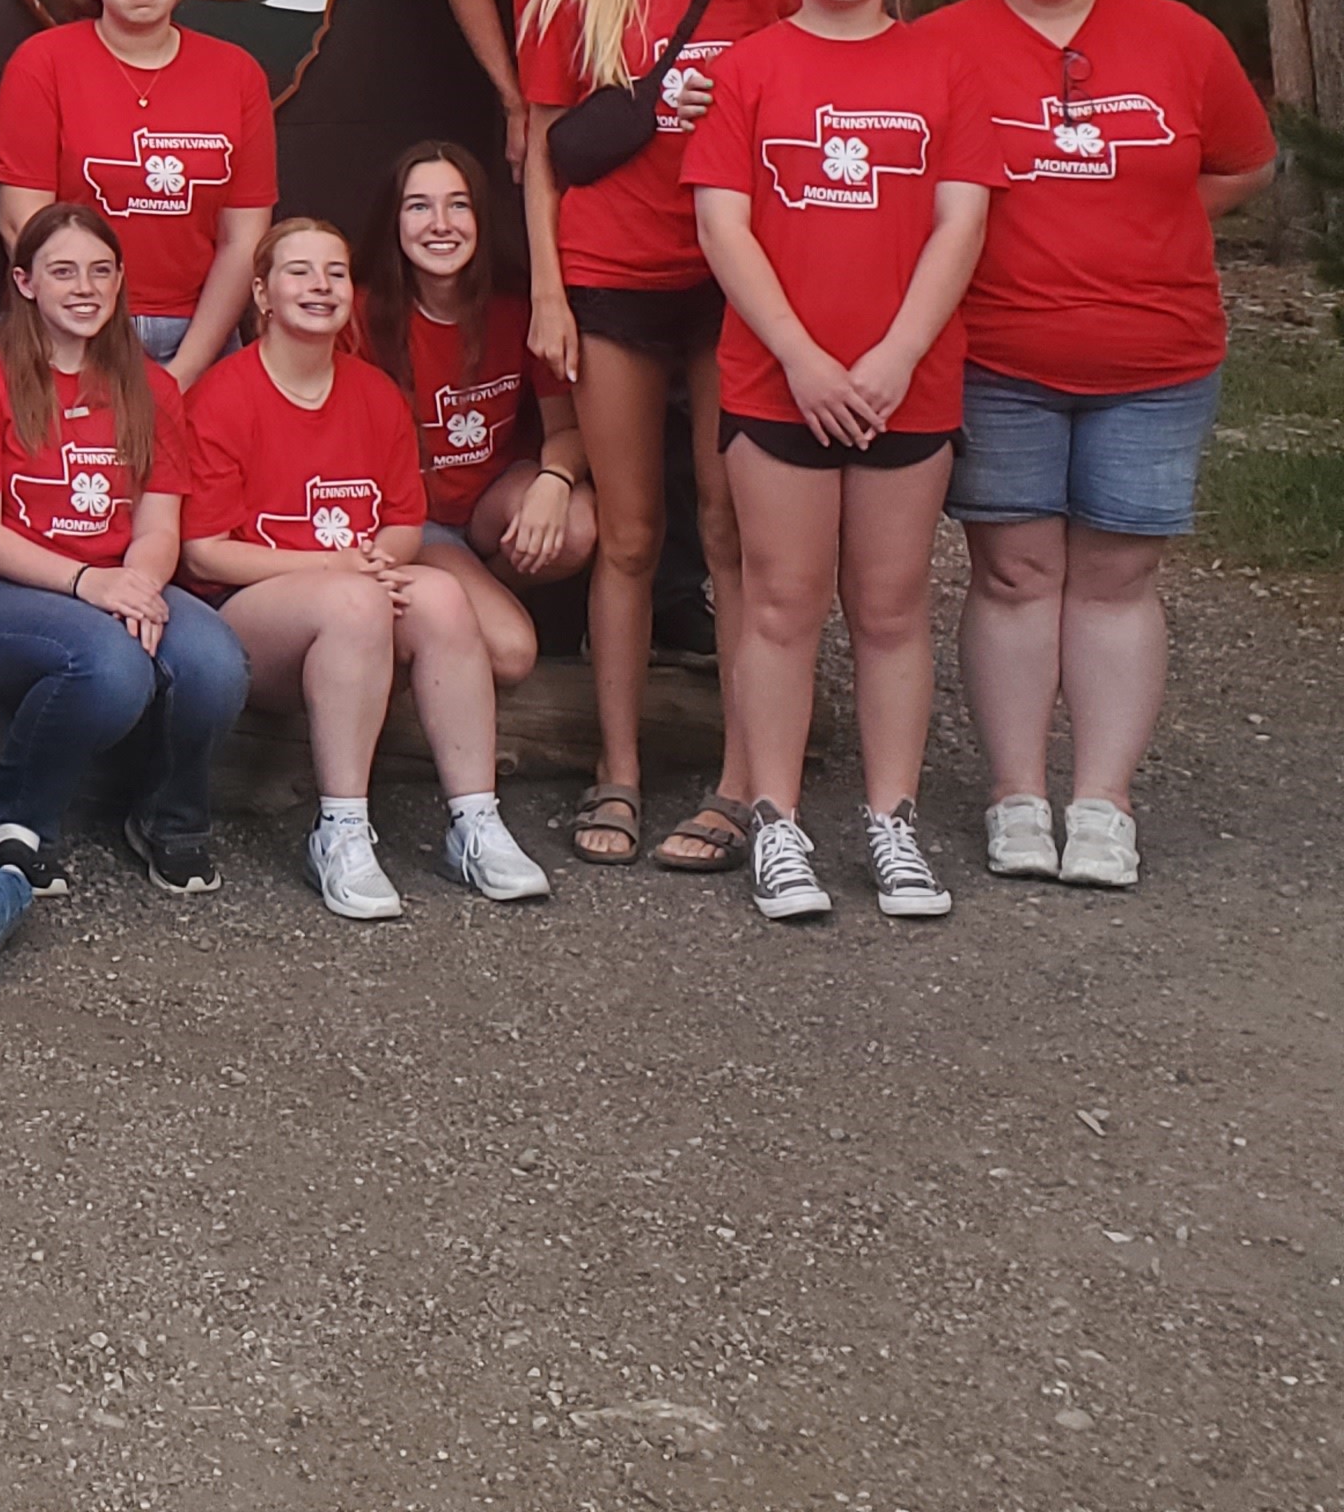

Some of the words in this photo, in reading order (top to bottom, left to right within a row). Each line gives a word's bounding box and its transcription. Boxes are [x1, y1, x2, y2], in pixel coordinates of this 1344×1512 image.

[823, 115, 921, 133] PENNSYLVANIA
[140, 137, 225, 149] PENNSYLVANIA
[1035, 158, 1110, 174] MONTANA
[804, 185, 872, 203] MONTANA
[128, 197, 185, 210] MONTANA
[68, 453, 120, 466] PENNSY
